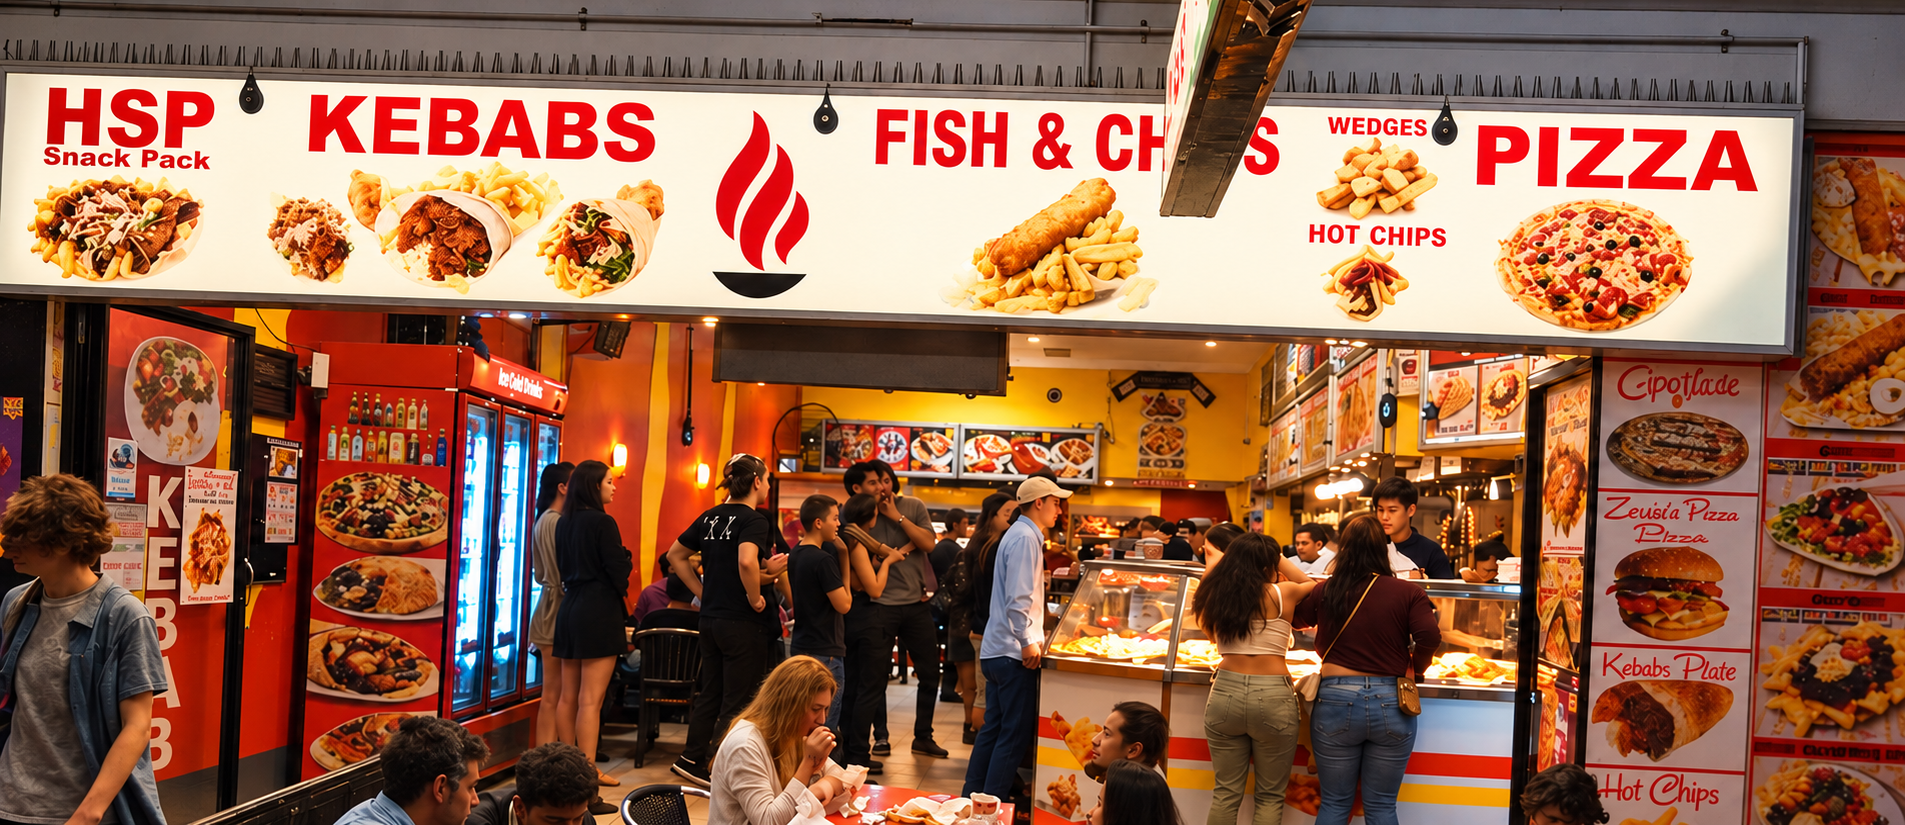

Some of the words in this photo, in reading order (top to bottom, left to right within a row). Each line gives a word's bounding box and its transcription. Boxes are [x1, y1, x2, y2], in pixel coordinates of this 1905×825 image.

[47, 87, 215, 148] HSP
[309, 94, 656, 163] KEBABS
[1328, 116, 1428, 137] WEDGES
[43, 146, 131, 168] Snack
[141, 148, 211, 170] Pack
[875, 108, 1009, 168] FISH
[1032, 112, 1074, 170] &
[1096, 113, 1281, 176] CHS
[1477, 124, 1759, 192] PIZZA
[1308, 223, 1361, 245] HOT
[1370, 225, 1447, 248] CHIPS
[1602, 652, 1671, 680] Kebabs
[1673, 652, 1737, 681] Plate
[1598, 773, 1644, 802] Hot
[1649, 773, 1720, 812] Chips
